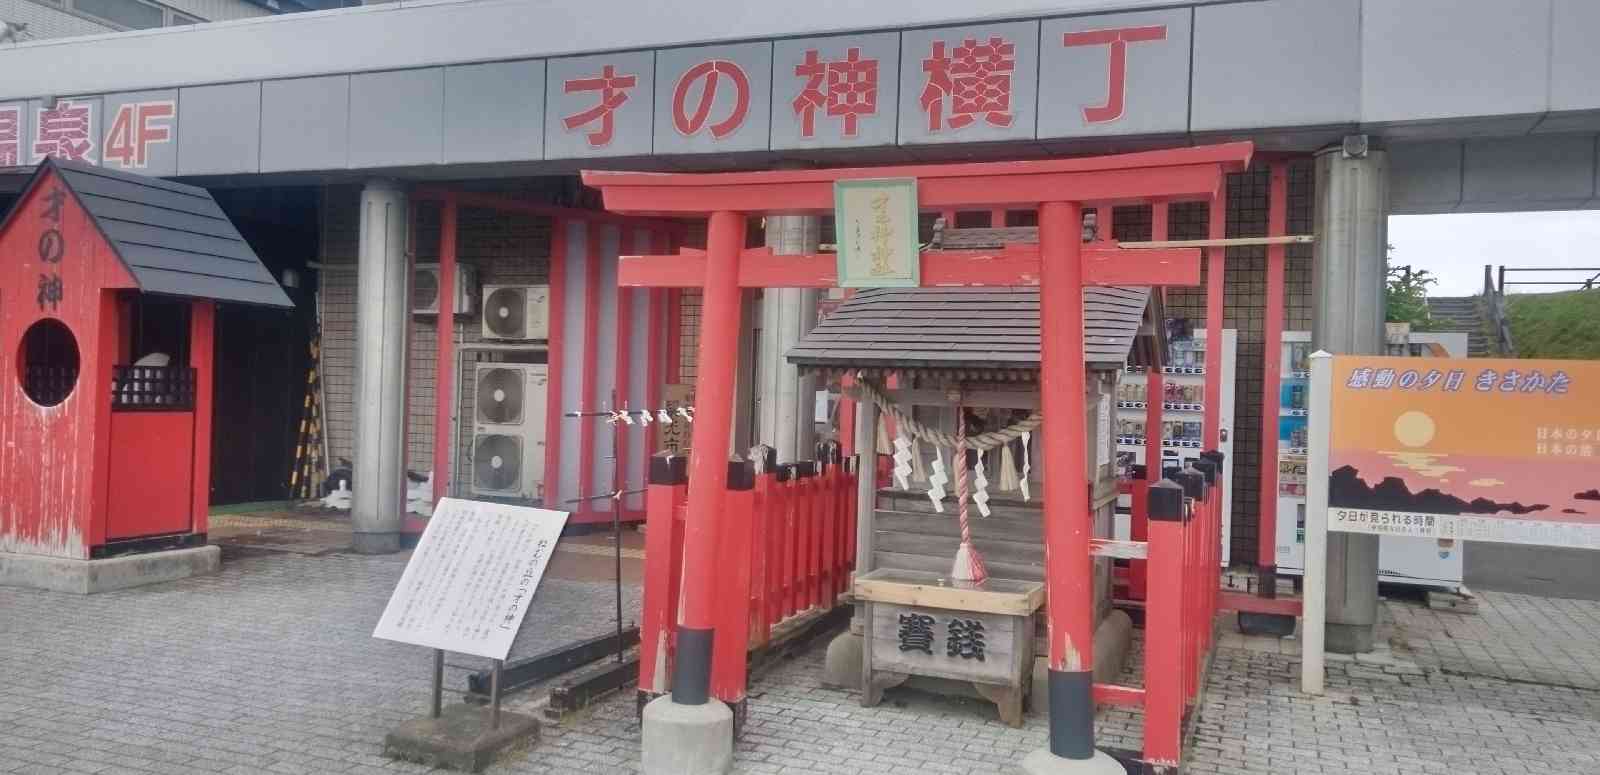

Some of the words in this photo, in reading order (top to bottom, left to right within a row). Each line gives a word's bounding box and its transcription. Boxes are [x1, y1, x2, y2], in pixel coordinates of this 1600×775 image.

[562, 24, 1168, 148] 才の神横丁
[37, 187, 66, 312] 才の神
[1347, 367, 1466, 392] 感動の夕日
[1474, 369, 1572, 394] きさかた
[1536, 425, 1600, 441] 日本の夕
[1337, 510, 1435, 528] 夕日が見られる時間
